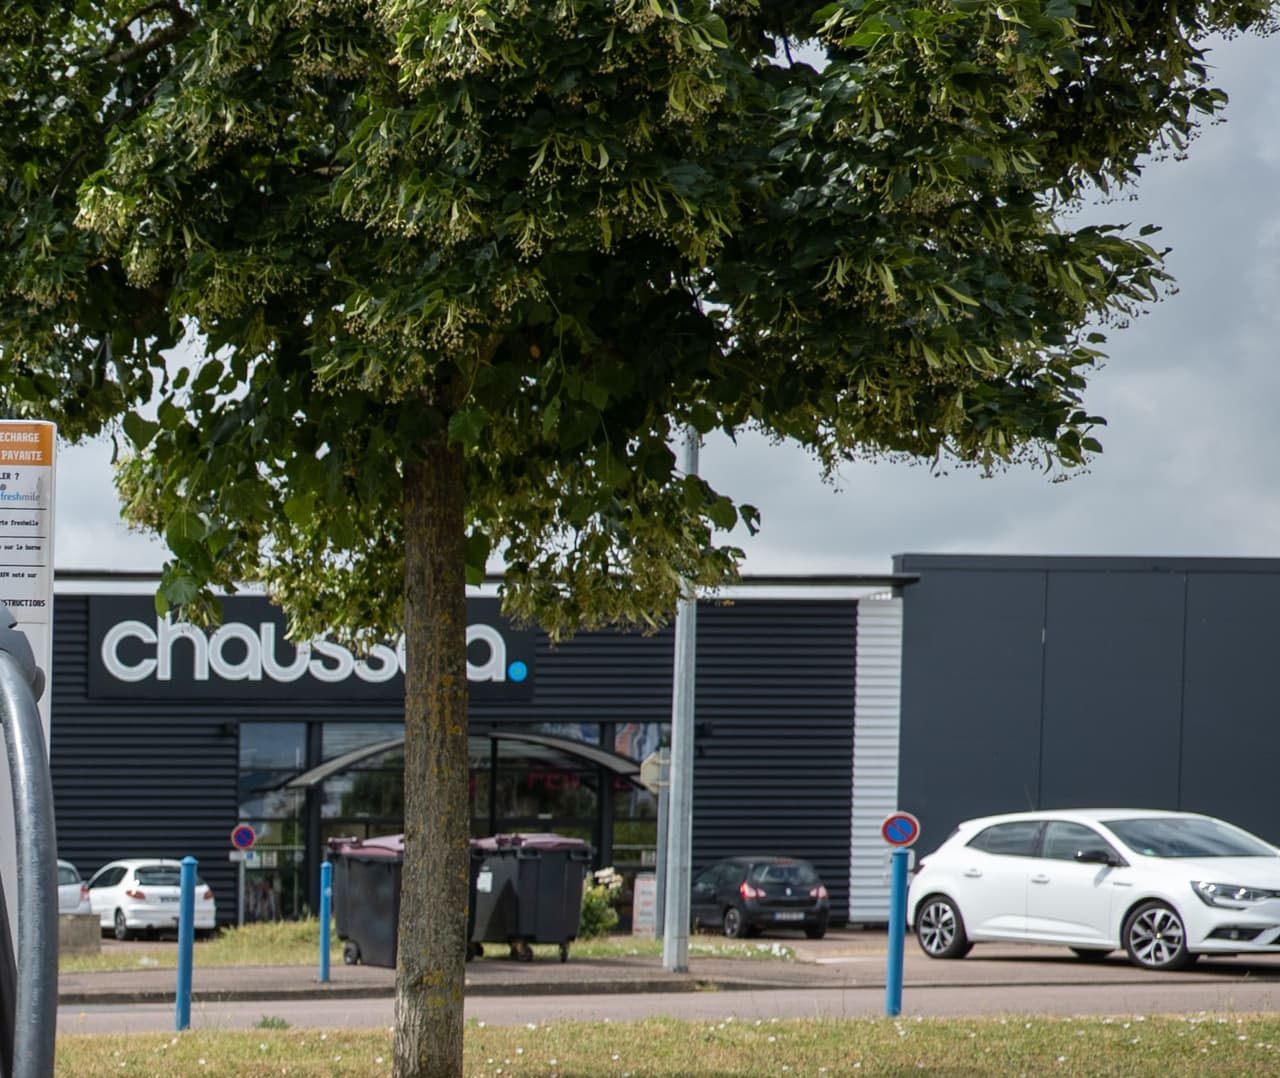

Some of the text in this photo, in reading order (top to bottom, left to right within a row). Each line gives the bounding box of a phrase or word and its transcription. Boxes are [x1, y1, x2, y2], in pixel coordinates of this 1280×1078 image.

[1, 450, 42, 460] PAYANTE
[0, 490, 40, 501] freshmile
[2, 599, 46, 608] STRUCTIONS
